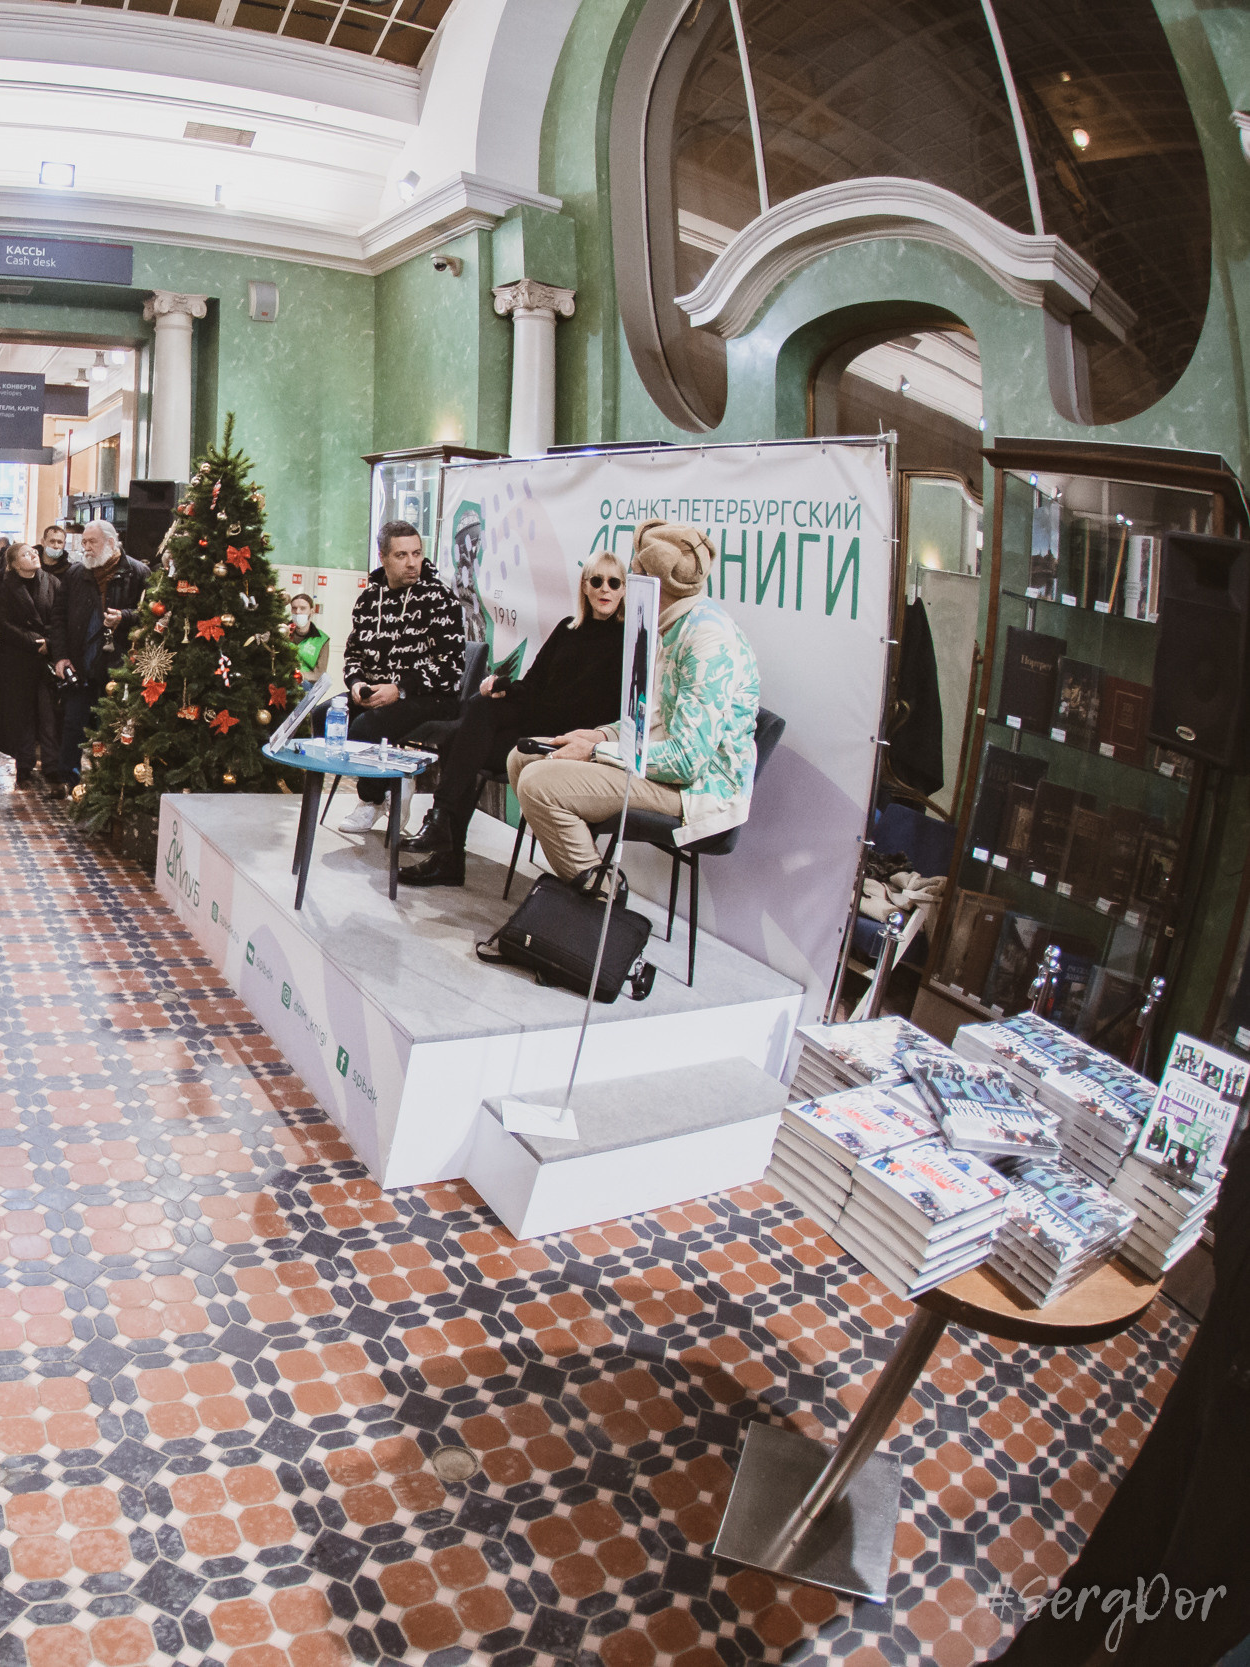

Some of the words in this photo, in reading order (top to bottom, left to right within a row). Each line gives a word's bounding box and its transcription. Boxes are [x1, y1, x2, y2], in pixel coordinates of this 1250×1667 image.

[5, 255, 30, 266] Cash
[32, 257, 57, 268] desk
[6, 245, 46, 257] КАССЫ
[2, 383, 37, 391] КОНВЕРТЫ
[17, 405, 40, 413] КАРТЫ
[615, 495, 861, 532] САНКТ-ПЕТЕРБУРГСКИЙ
[706, 527, 861, 621] НИГИ
[493, 606, 518, 627] 1919
[293, 999, 329, 1047] dom_knigi
[351, 1068, 378, 1108] spbdk
[931, 1076, 1020, 1107] РОК
[1164, 1079, 1231, 1123] Стингрей
[1020, 1167, 1106, 1229] РОК
